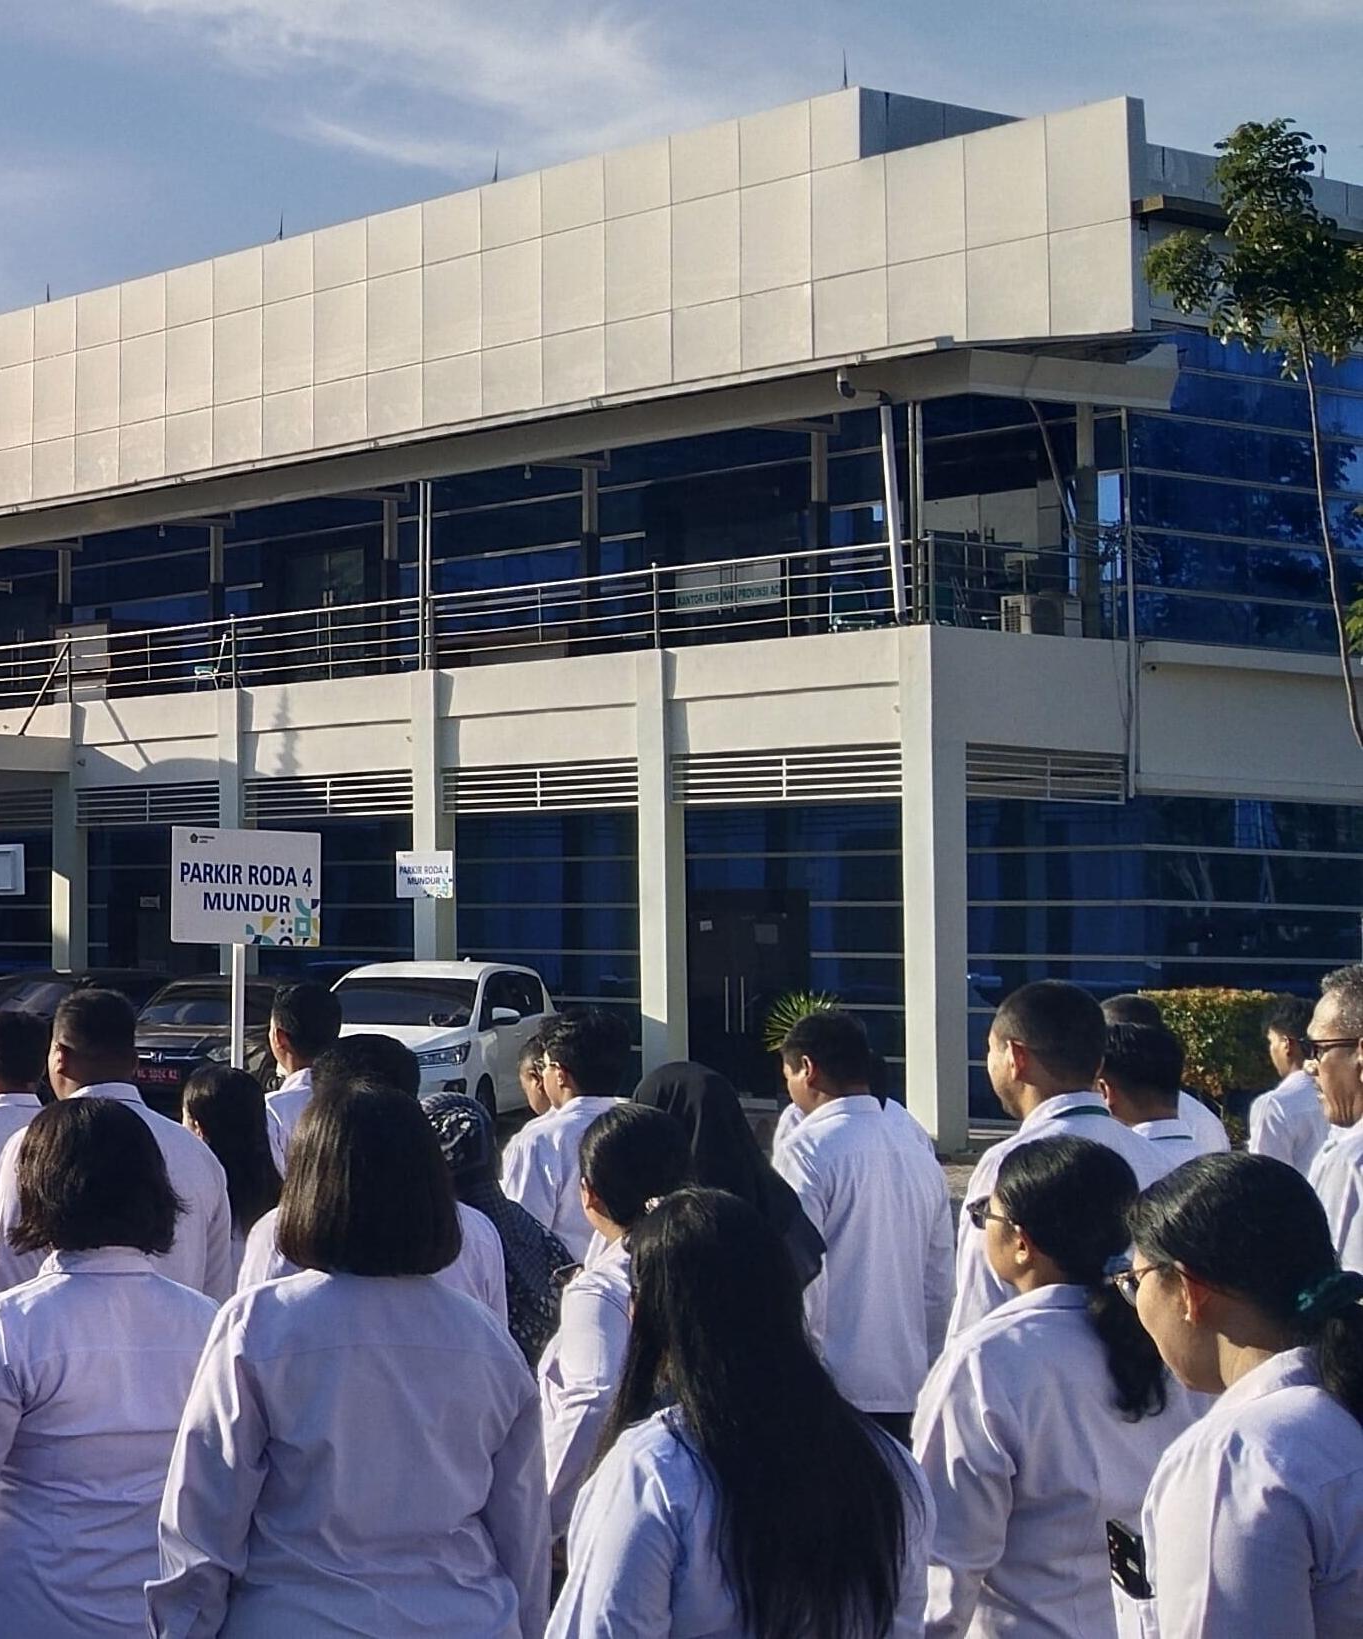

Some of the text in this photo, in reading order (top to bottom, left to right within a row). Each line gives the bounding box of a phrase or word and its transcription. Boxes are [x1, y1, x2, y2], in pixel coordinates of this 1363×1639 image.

[180, 862, 312, 887] PARKIR RODA 4
[203, 892, 291, 913] MUNDUR
